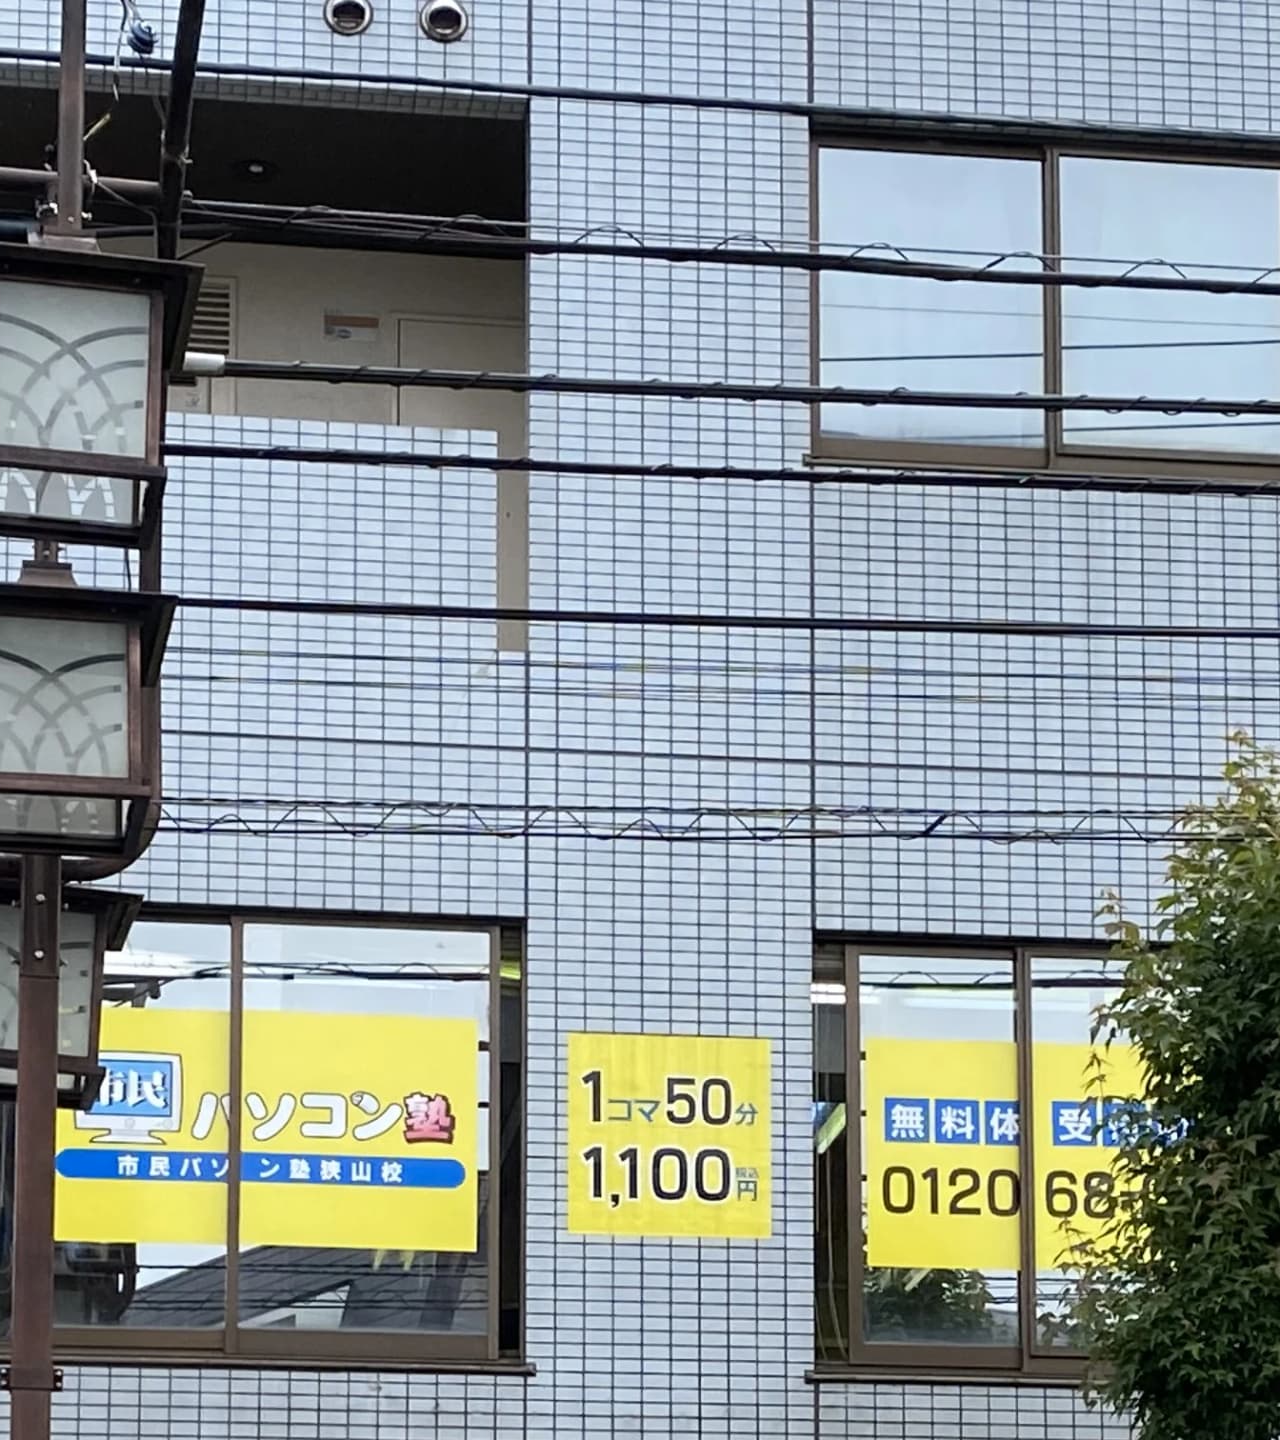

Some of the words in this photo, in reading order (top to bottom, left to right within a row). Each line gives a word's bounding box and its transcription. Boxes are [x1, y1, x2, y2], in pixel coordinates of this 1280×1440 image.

[117, 1155, 404, 1184] 市民パソン塾狭山校
